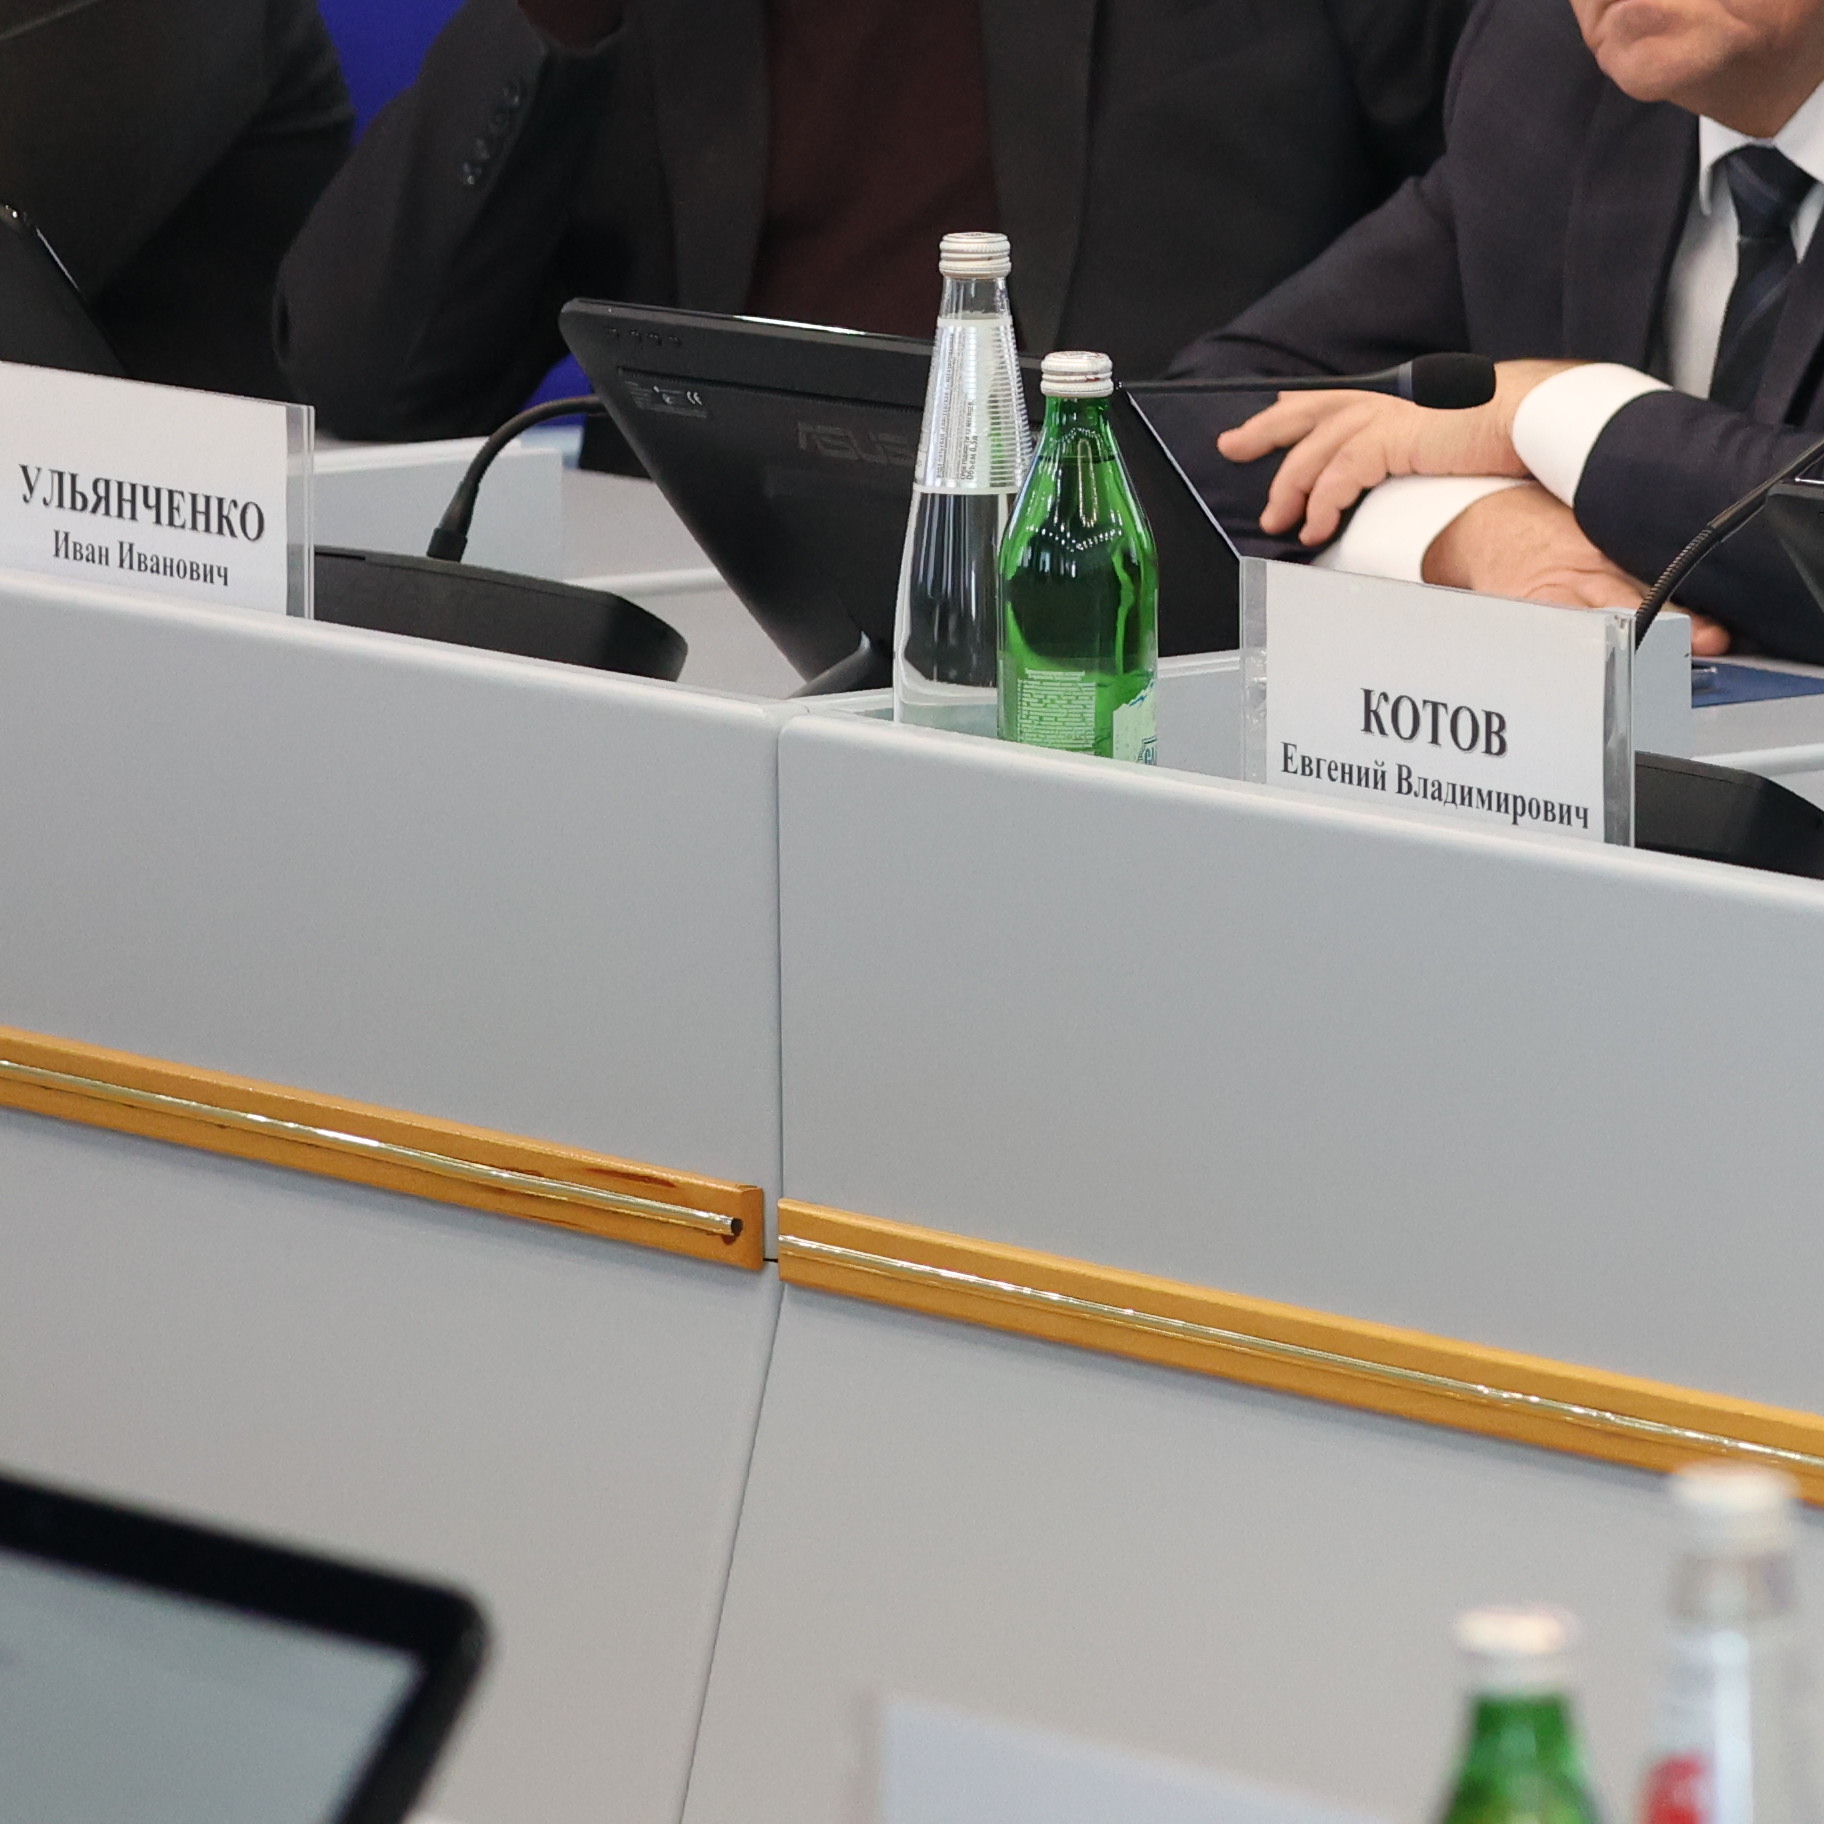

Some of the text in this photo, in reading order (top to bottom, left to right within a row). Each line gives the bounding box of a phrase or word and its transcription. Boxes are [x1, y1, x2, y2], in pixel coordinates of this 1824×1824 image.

[18, 463, 266, 543] УЛЬЯНЧЕНКО
[53, 529, 229, 587] Иван Иванович
[1360, 687, 1509, 759] КОТОВ
[1280, 741, 1590, 830] Евгений Владимирович
